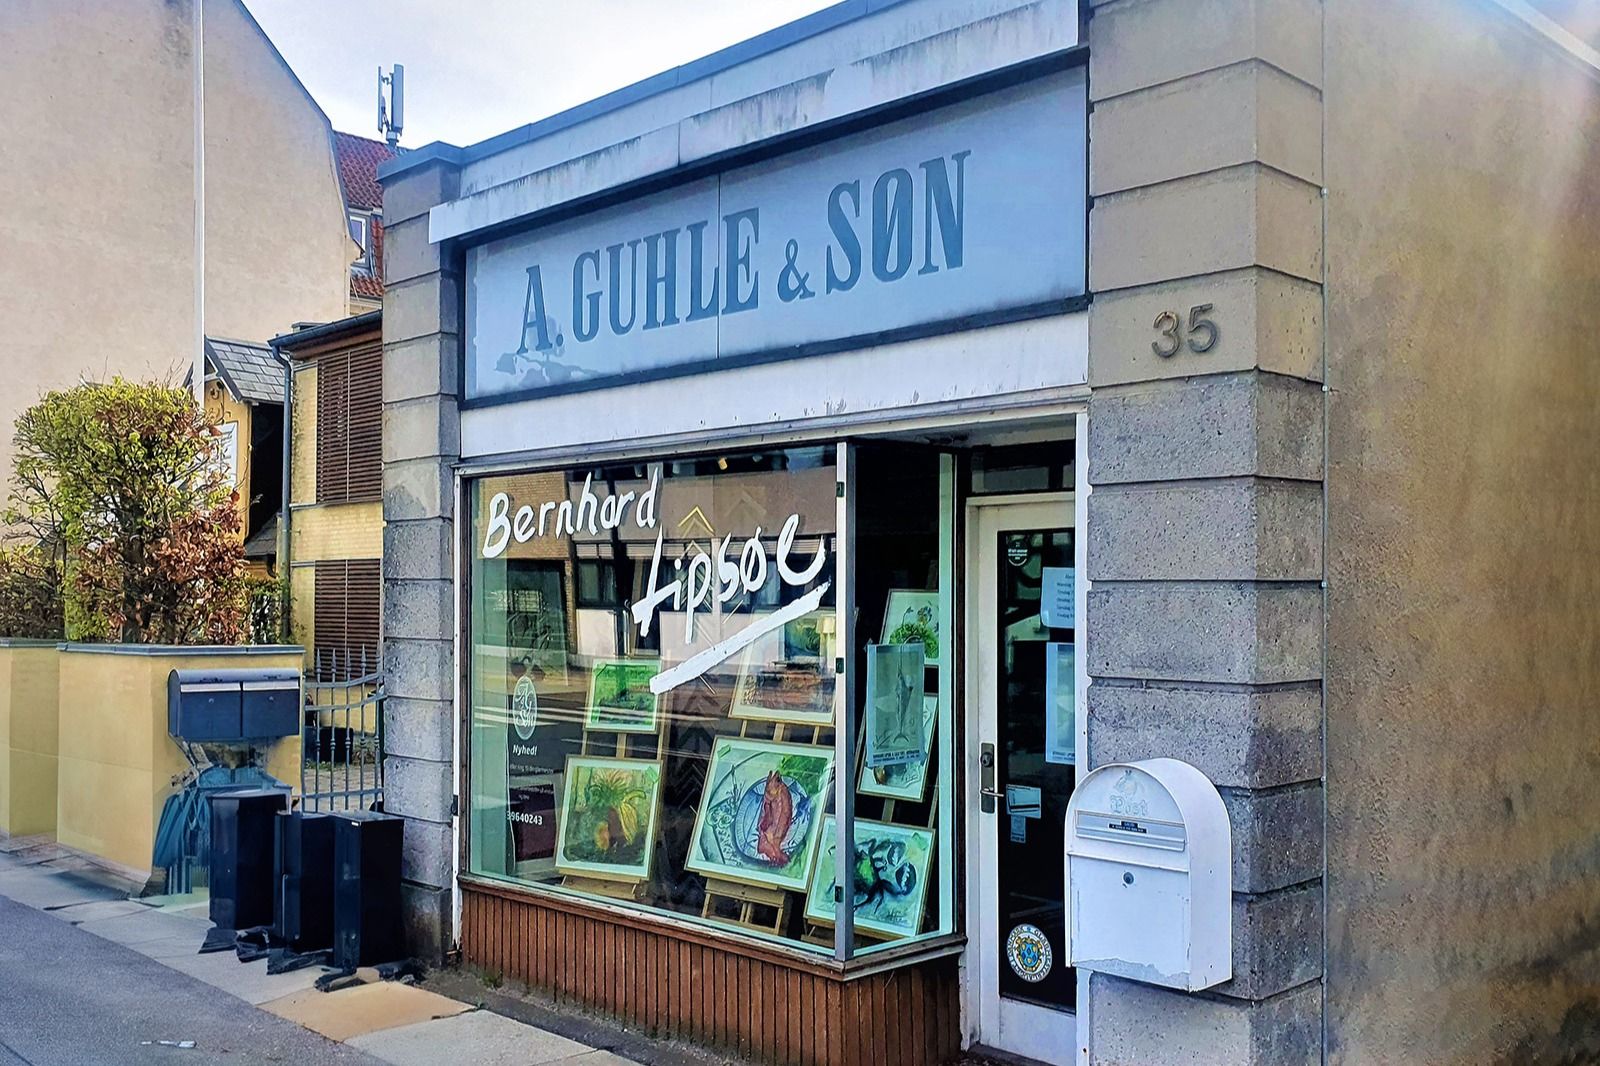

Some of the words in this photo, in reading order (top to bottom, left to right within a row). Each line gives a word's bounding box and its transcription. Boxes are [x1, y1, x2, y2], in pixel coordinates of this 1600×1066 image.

[518, 265, 564, 354] A.
[572, 207, 760, 343] GUHLE
[776, 238, 815, 303] &
[826, 150, 972, 296] SØN
[1152, 303, 1217, 358] 35
[482, 467, 658, 558] Bernhard
